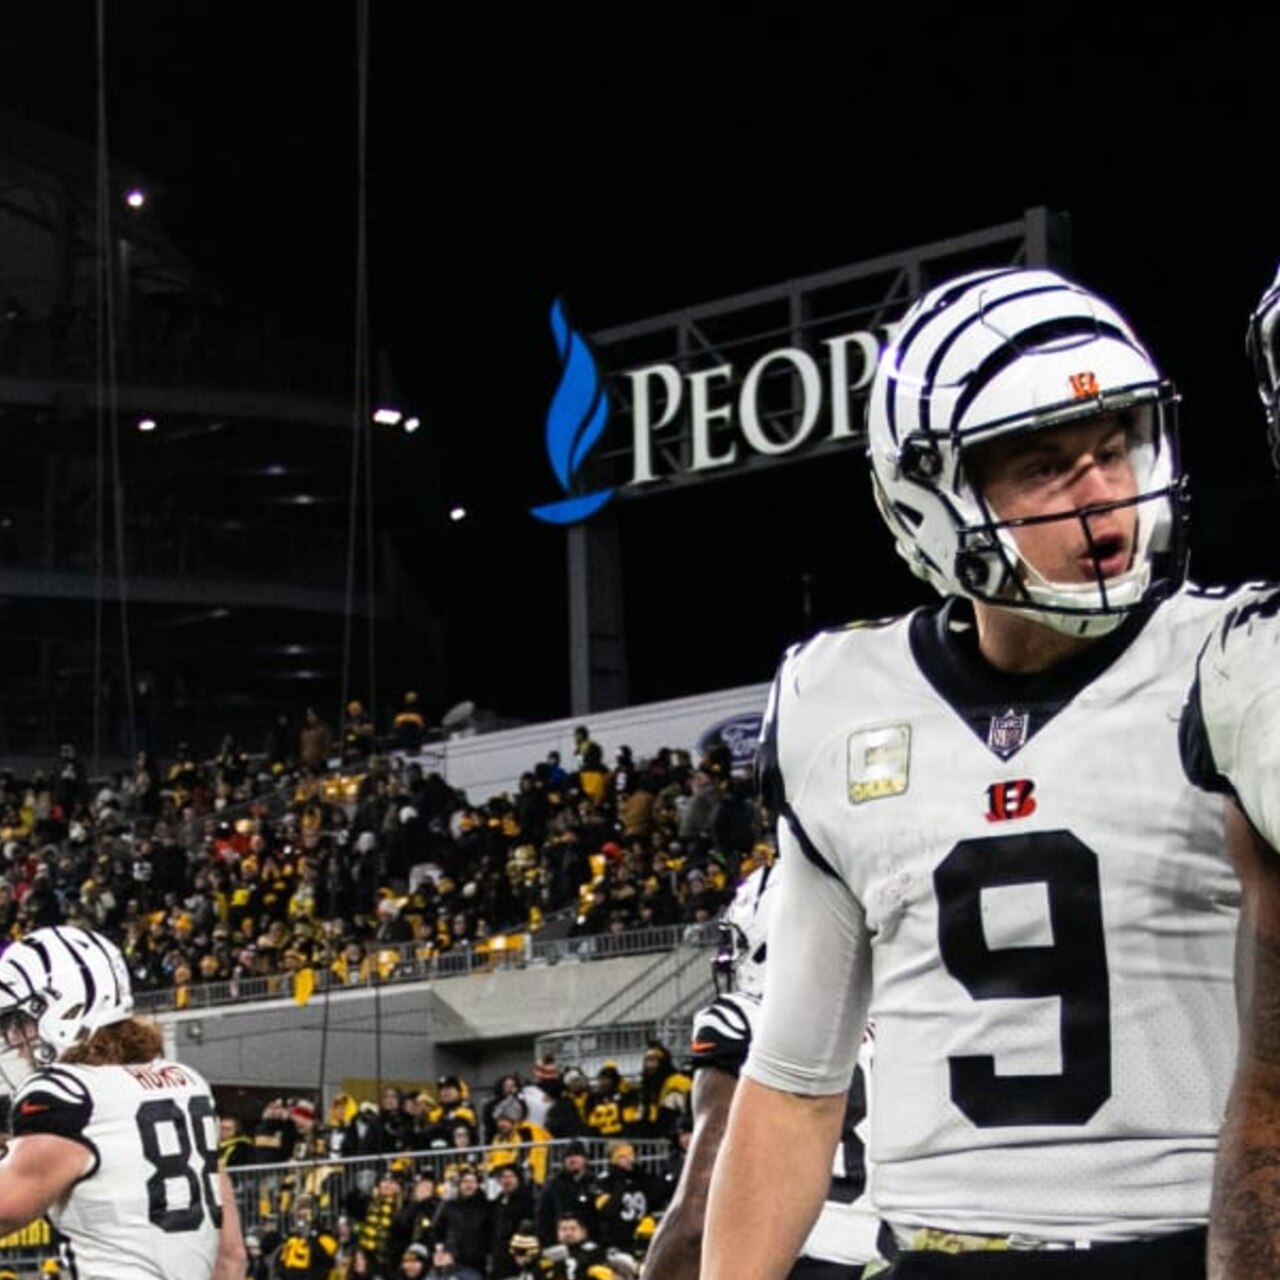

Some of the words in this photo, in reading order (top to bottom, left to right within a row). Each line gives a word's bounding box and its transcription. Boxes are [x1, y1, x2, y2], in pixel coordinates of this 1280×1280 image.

[623, 322, 902, 486] PEOP
[932, 829, 1112, 1128] 9
[135, 1095, 223, 1234] 88
